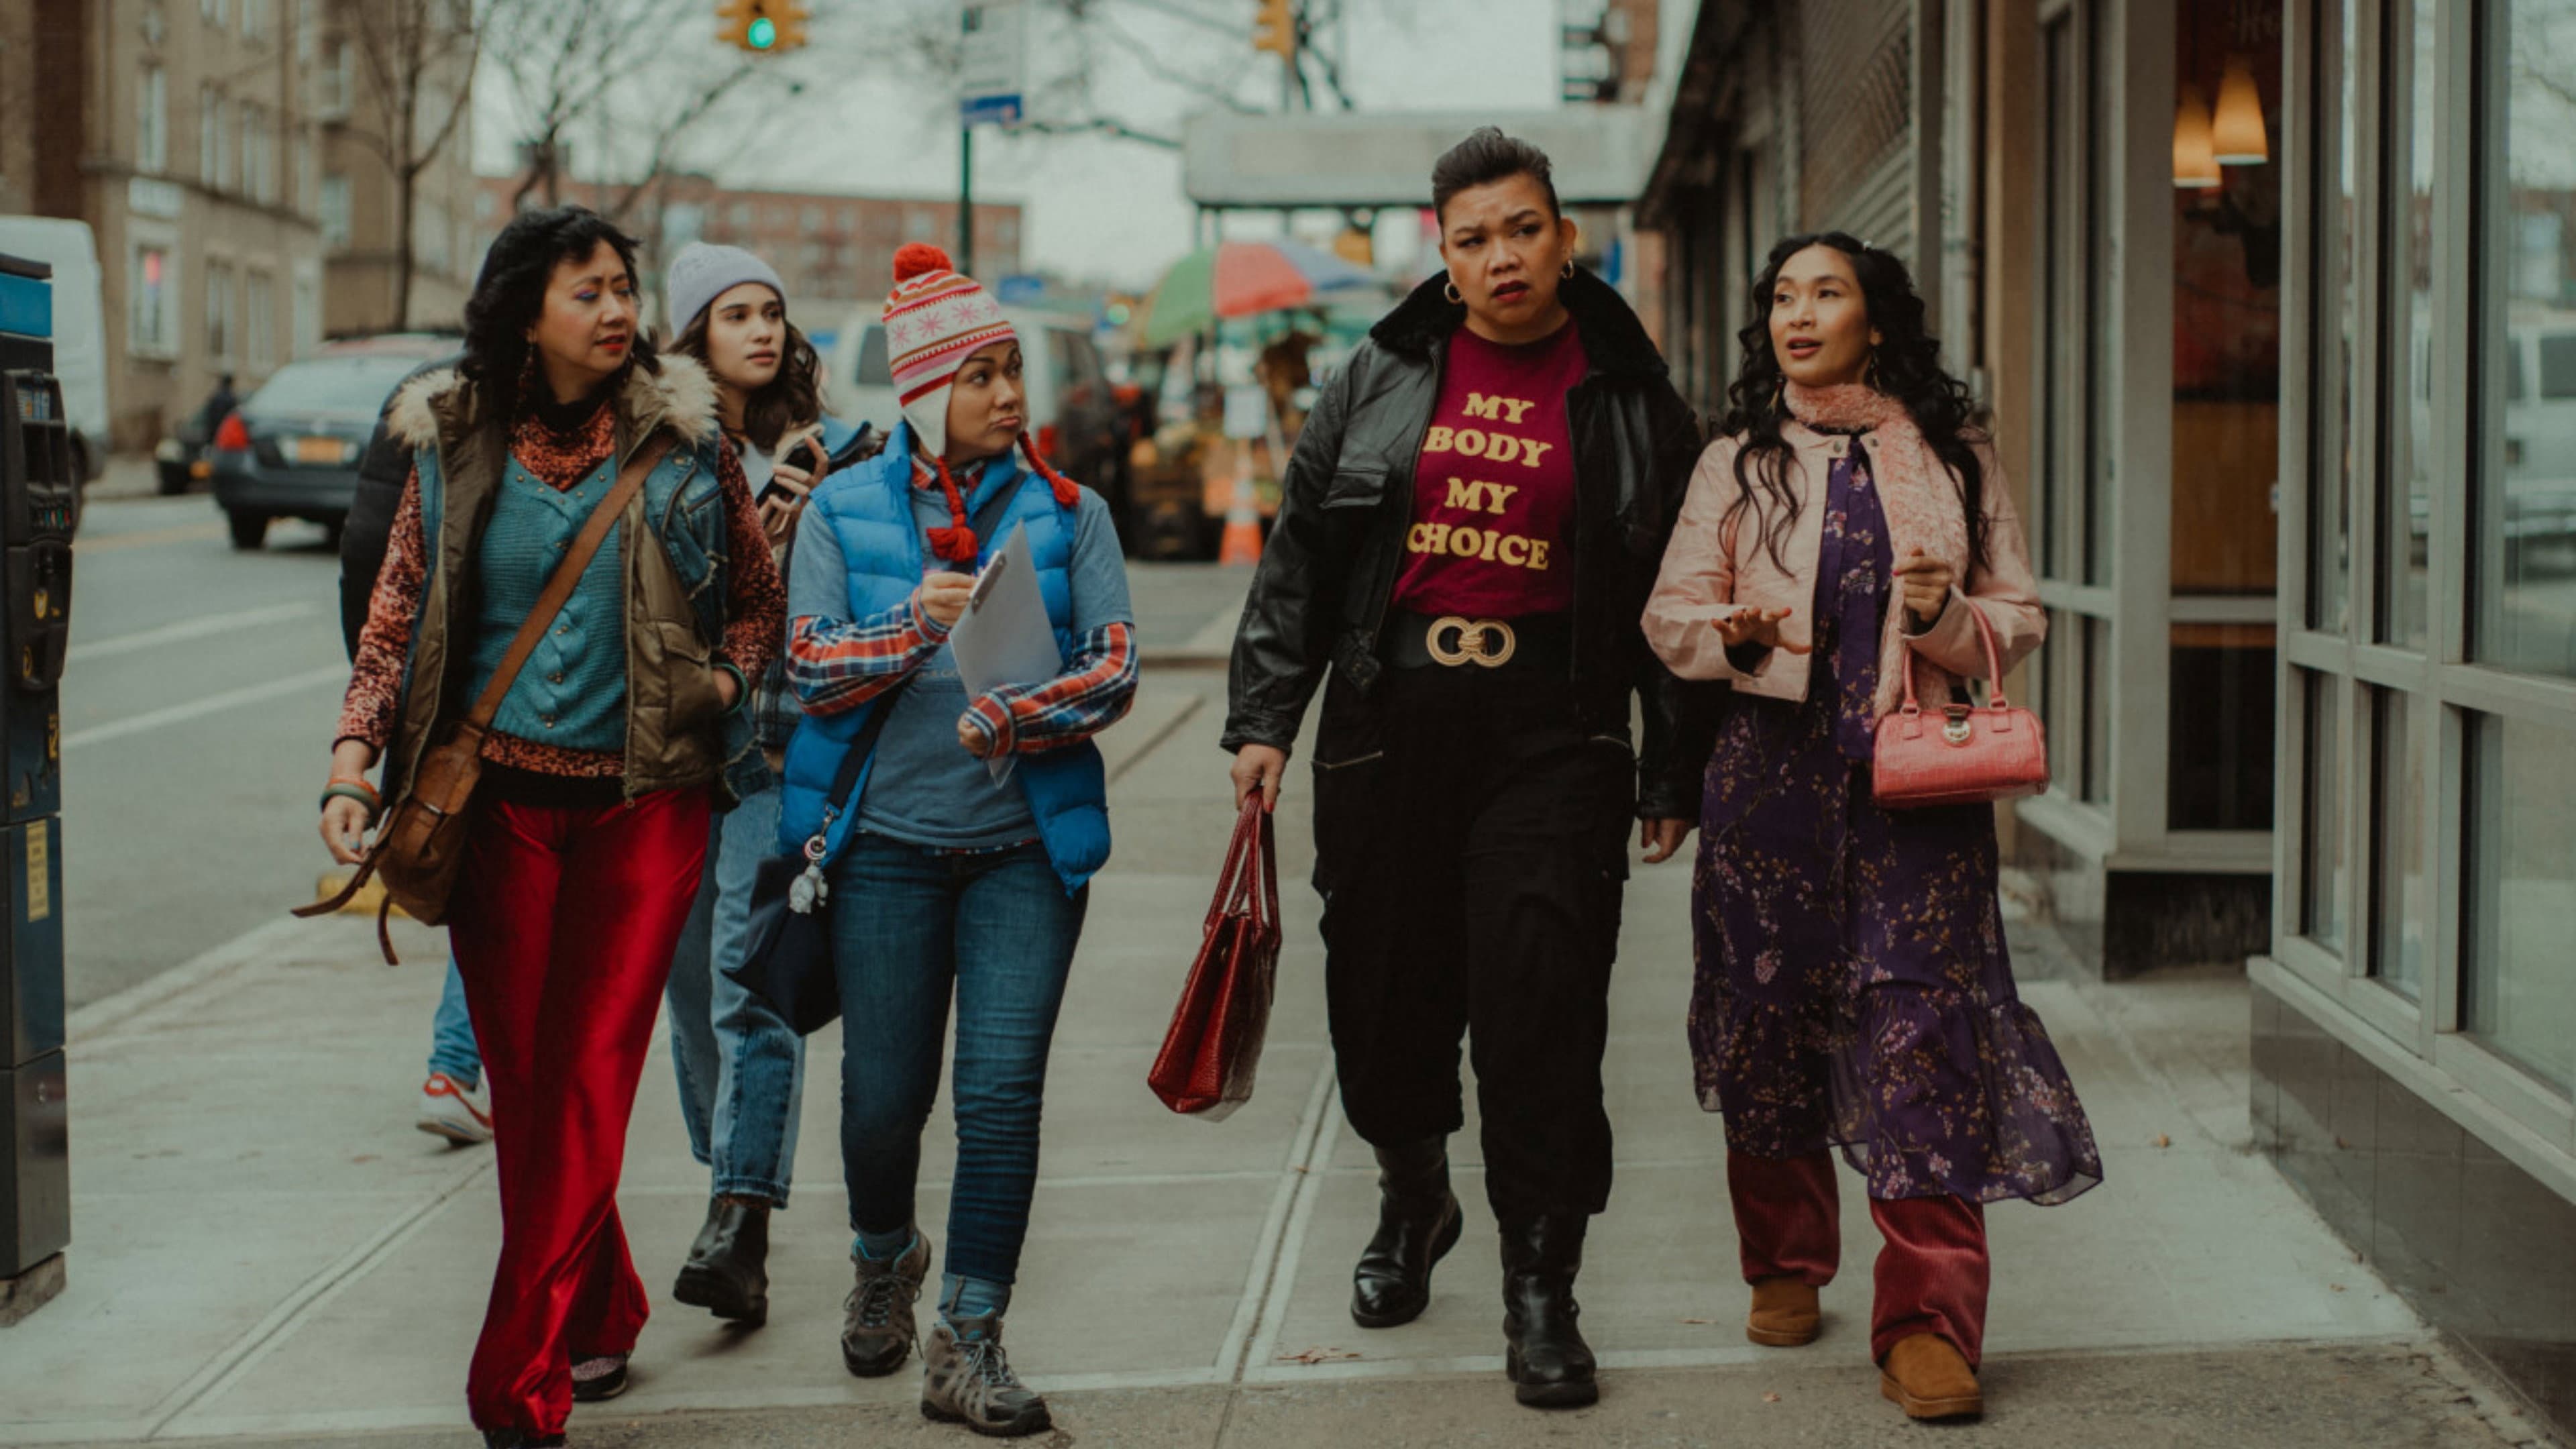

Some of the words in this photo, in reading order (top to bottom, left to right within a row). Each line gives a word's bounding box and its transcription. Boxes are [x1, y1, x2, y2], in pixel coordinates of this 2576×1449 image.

[1462, 392, 1534, 423] MY
[1423, 426, 1552, 467] BODY
[1444, 477, 1517, 514] MY
[1407, 523, 1550, 570] CHOICE
